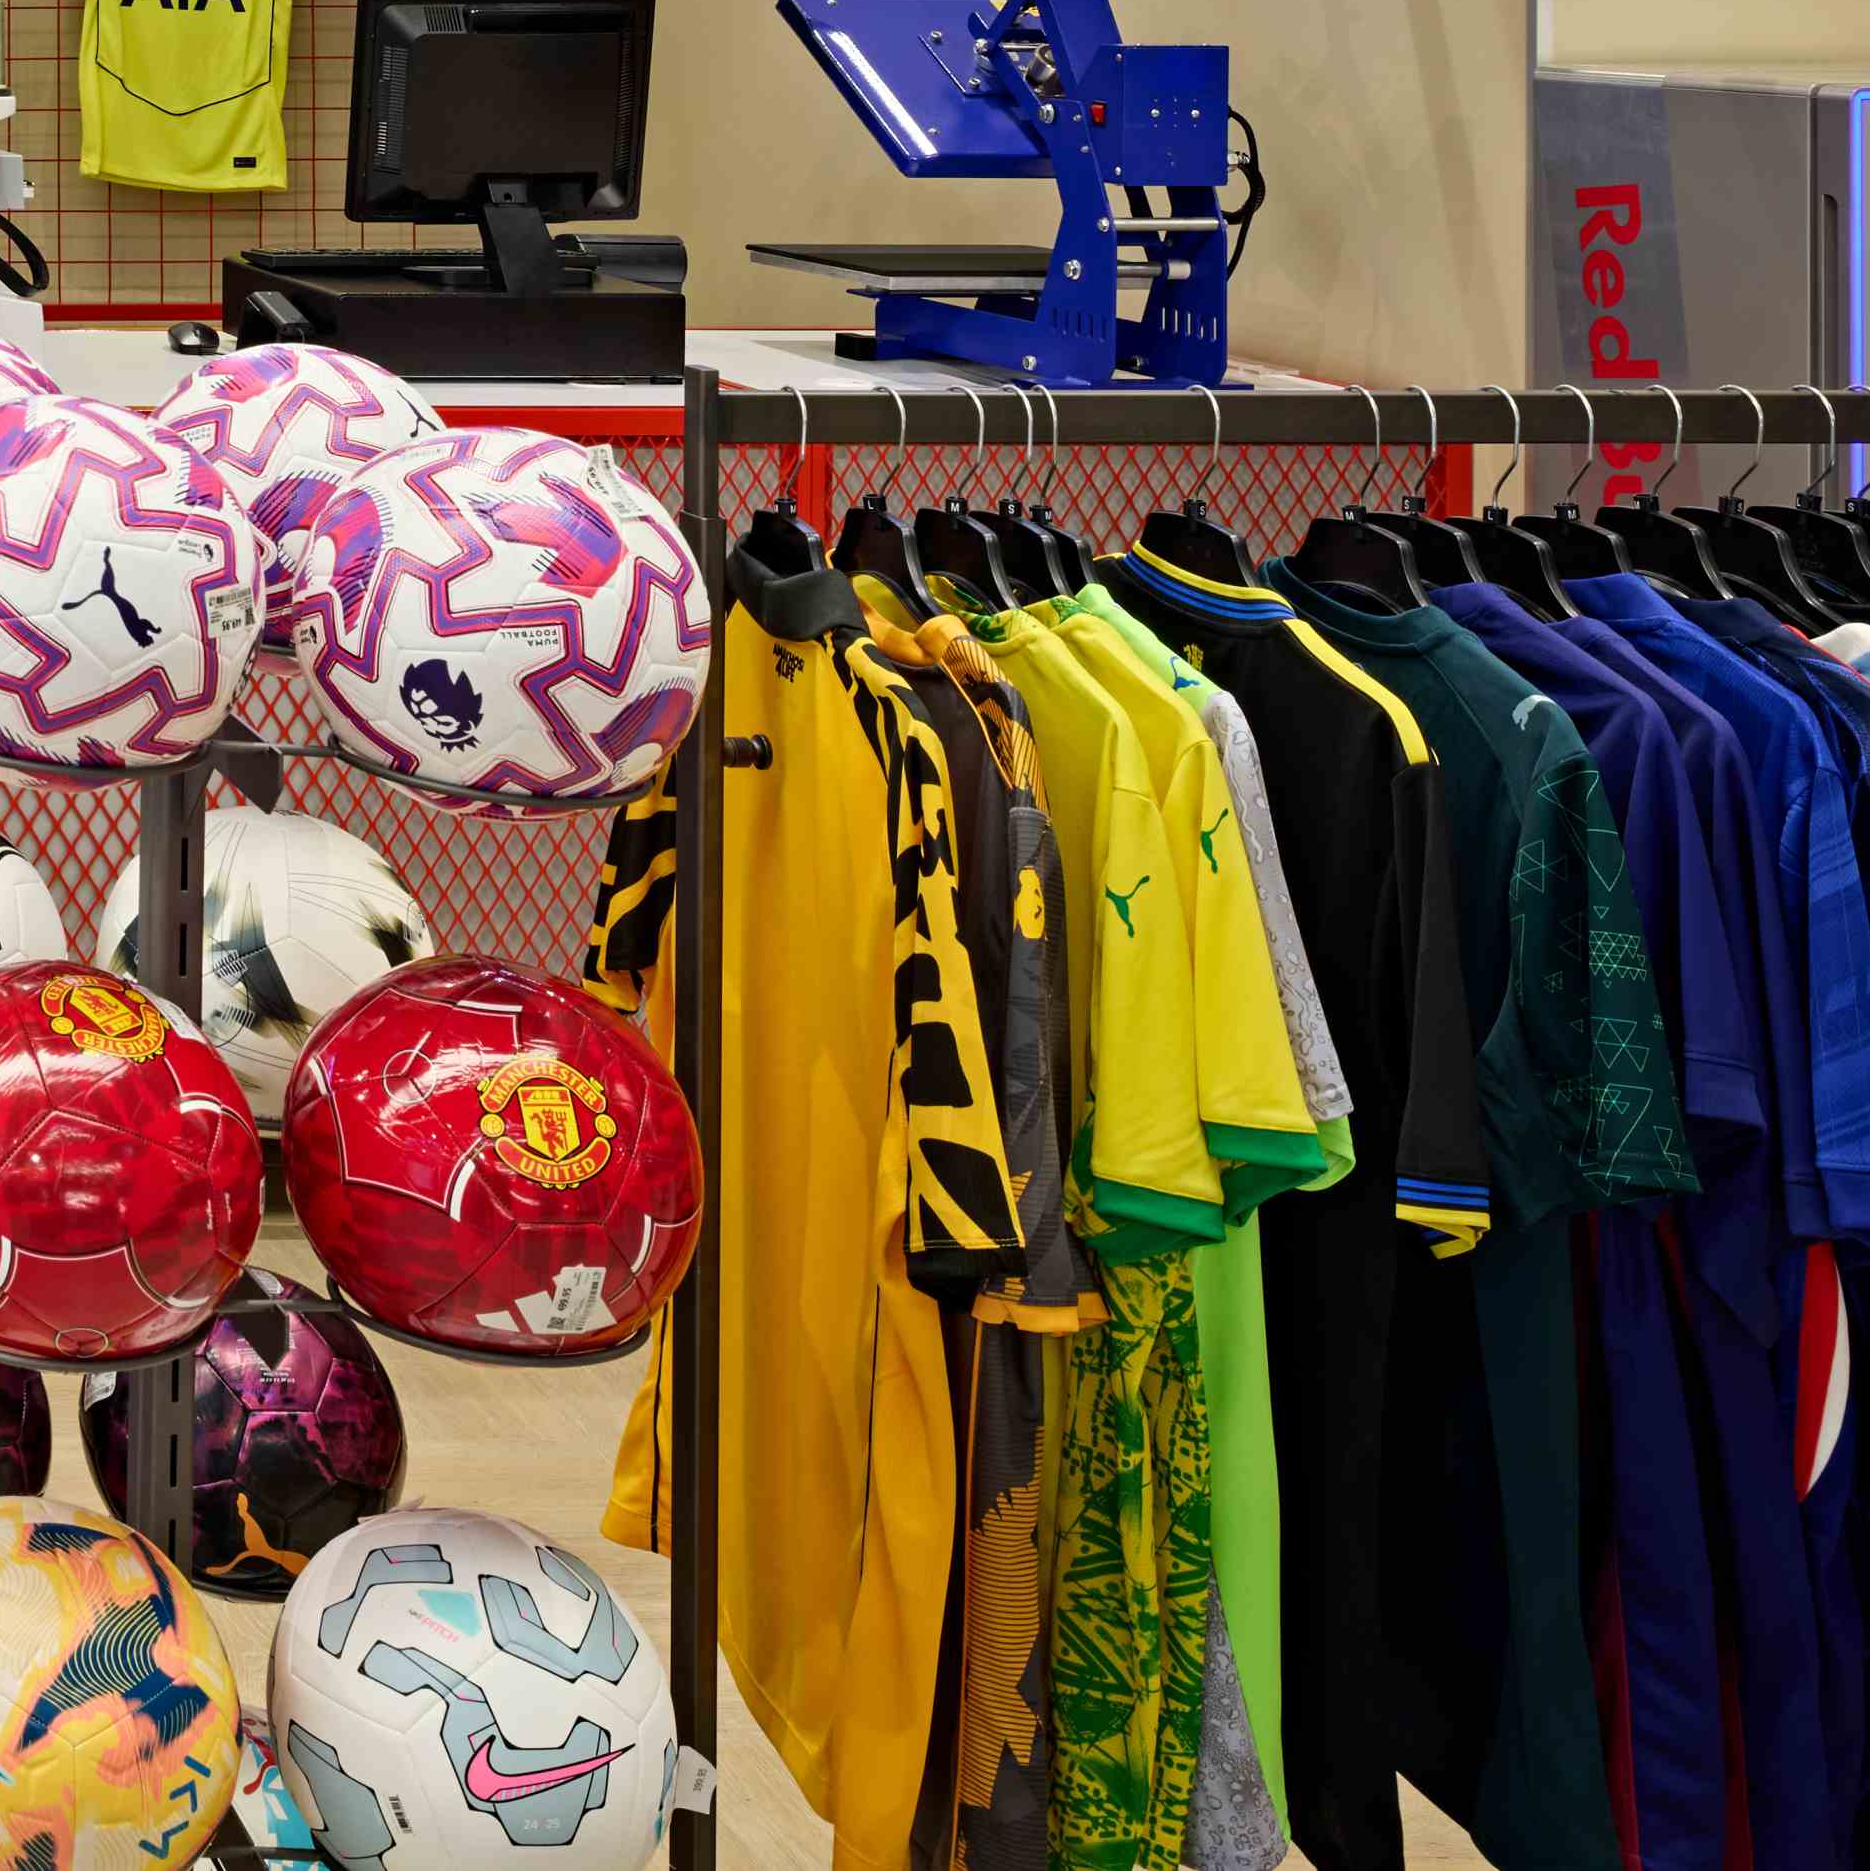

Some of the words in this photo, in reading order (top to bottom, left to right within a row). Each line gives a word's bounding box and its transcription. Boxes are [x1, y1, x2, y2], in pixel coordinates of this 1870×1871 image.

[1575, 184, 1659, 379] Red
[950, 501, 961, 513] M
[1008, 503, 1016, 515] S
[488, 1061, 599, 1106] MANCHESTER
[519, 1156, 597, 1181] UNITED
